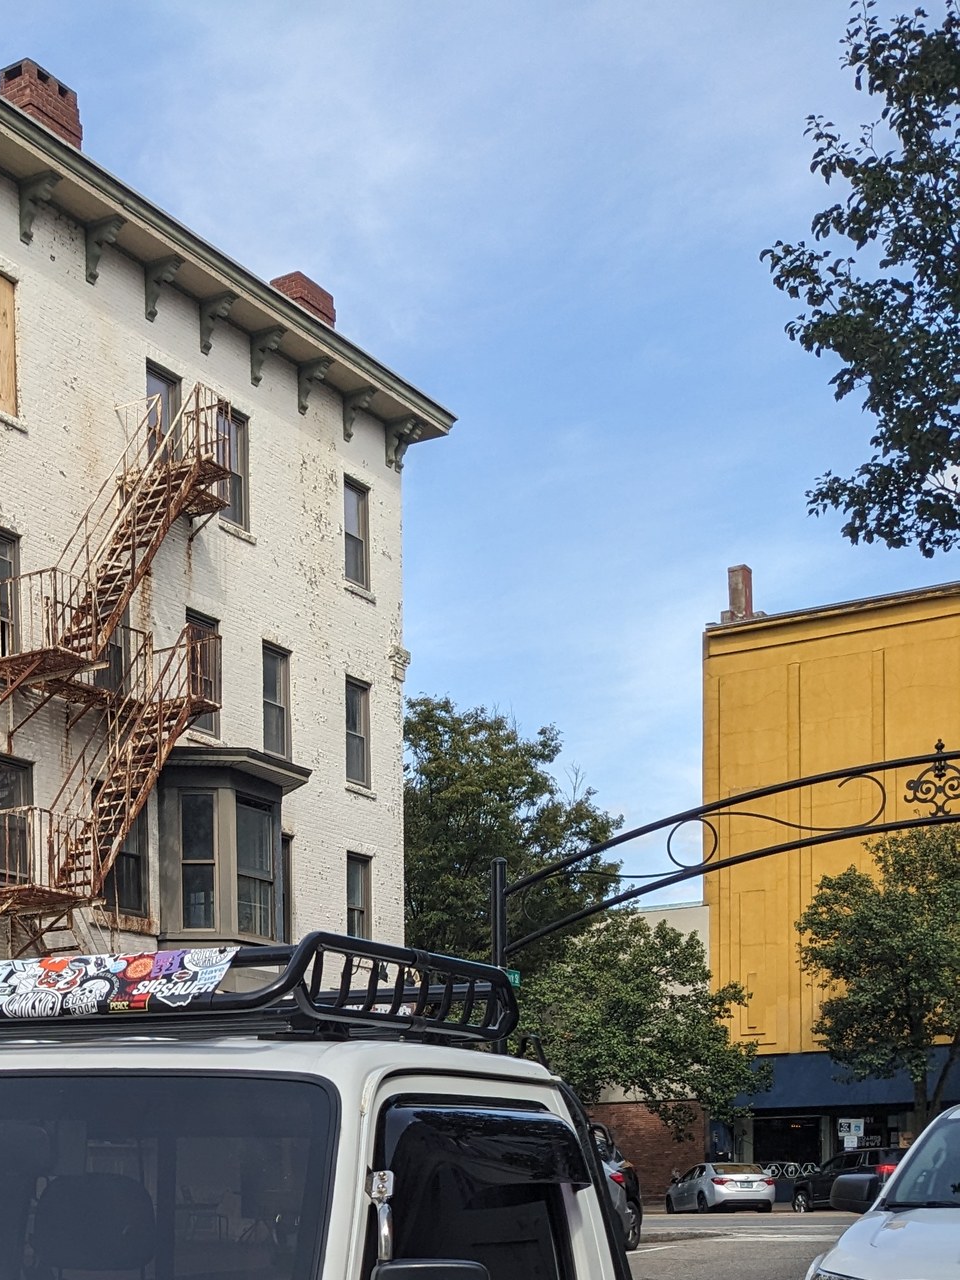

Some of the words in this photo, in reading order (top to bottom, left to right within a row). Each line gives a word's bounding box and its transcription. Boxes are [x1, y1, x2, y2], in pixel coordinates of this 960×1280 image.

[132, 979, 167, 995] SIG
[156, 980, 216, 997] SAUER
[71, 1002, 98, 1016] ROOM
